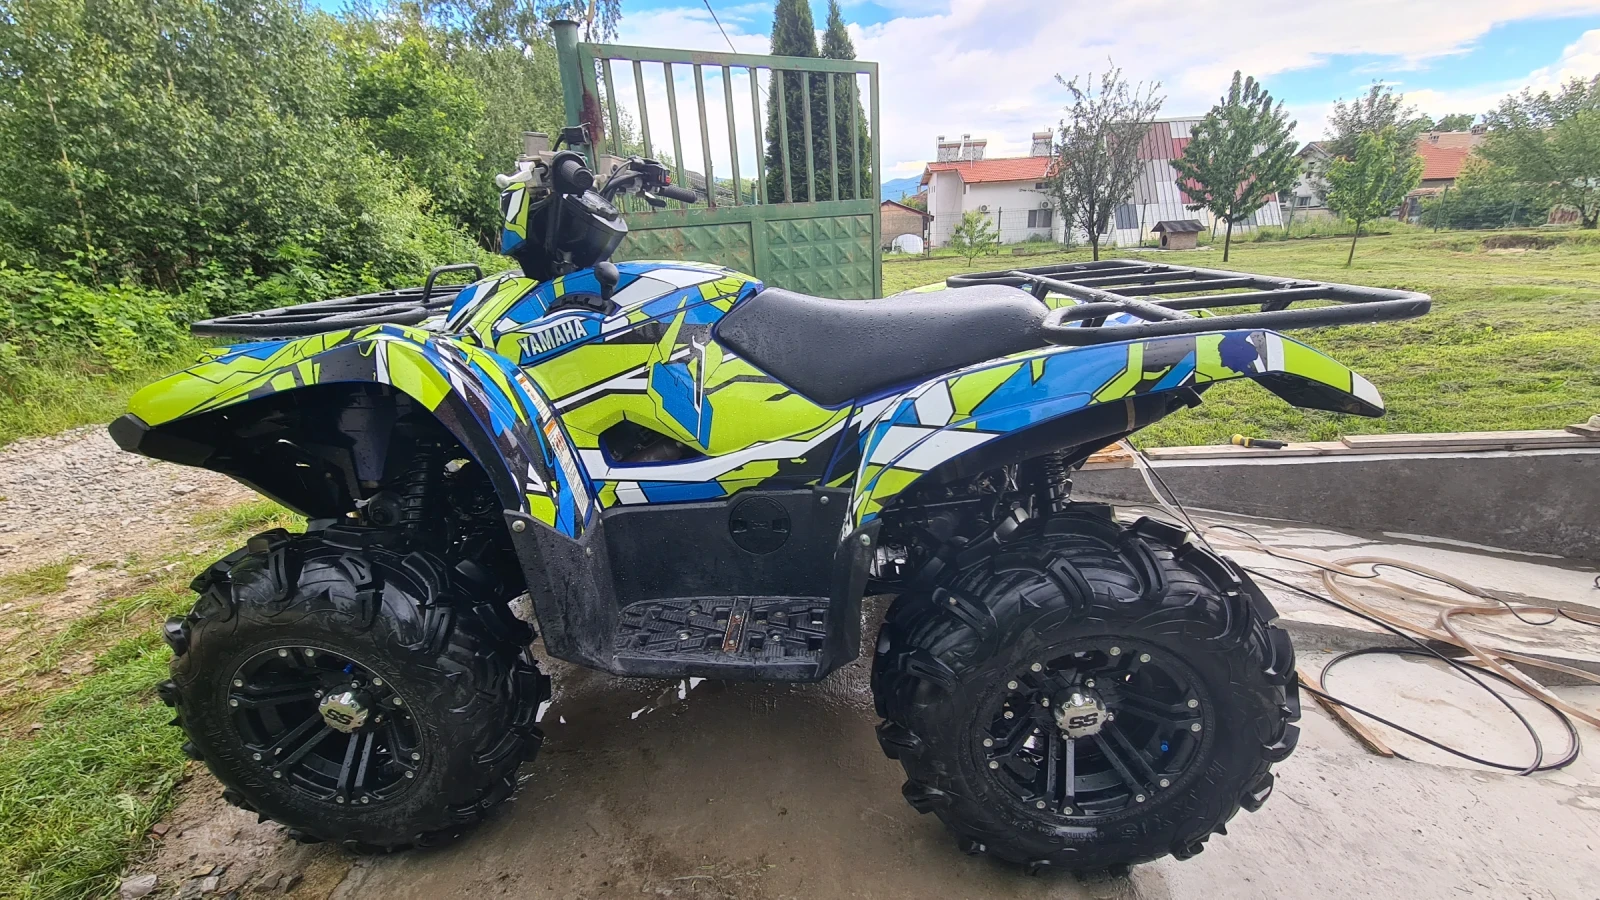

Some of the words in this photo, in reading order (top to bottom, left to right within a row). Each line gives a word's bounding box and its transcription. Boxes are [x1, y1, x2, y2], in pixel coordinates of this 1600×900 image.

[517, 319, 588, 358] YAMAHA
[325, 708, 354, 725] SS
[1068, 712, 1099, 729] SS
